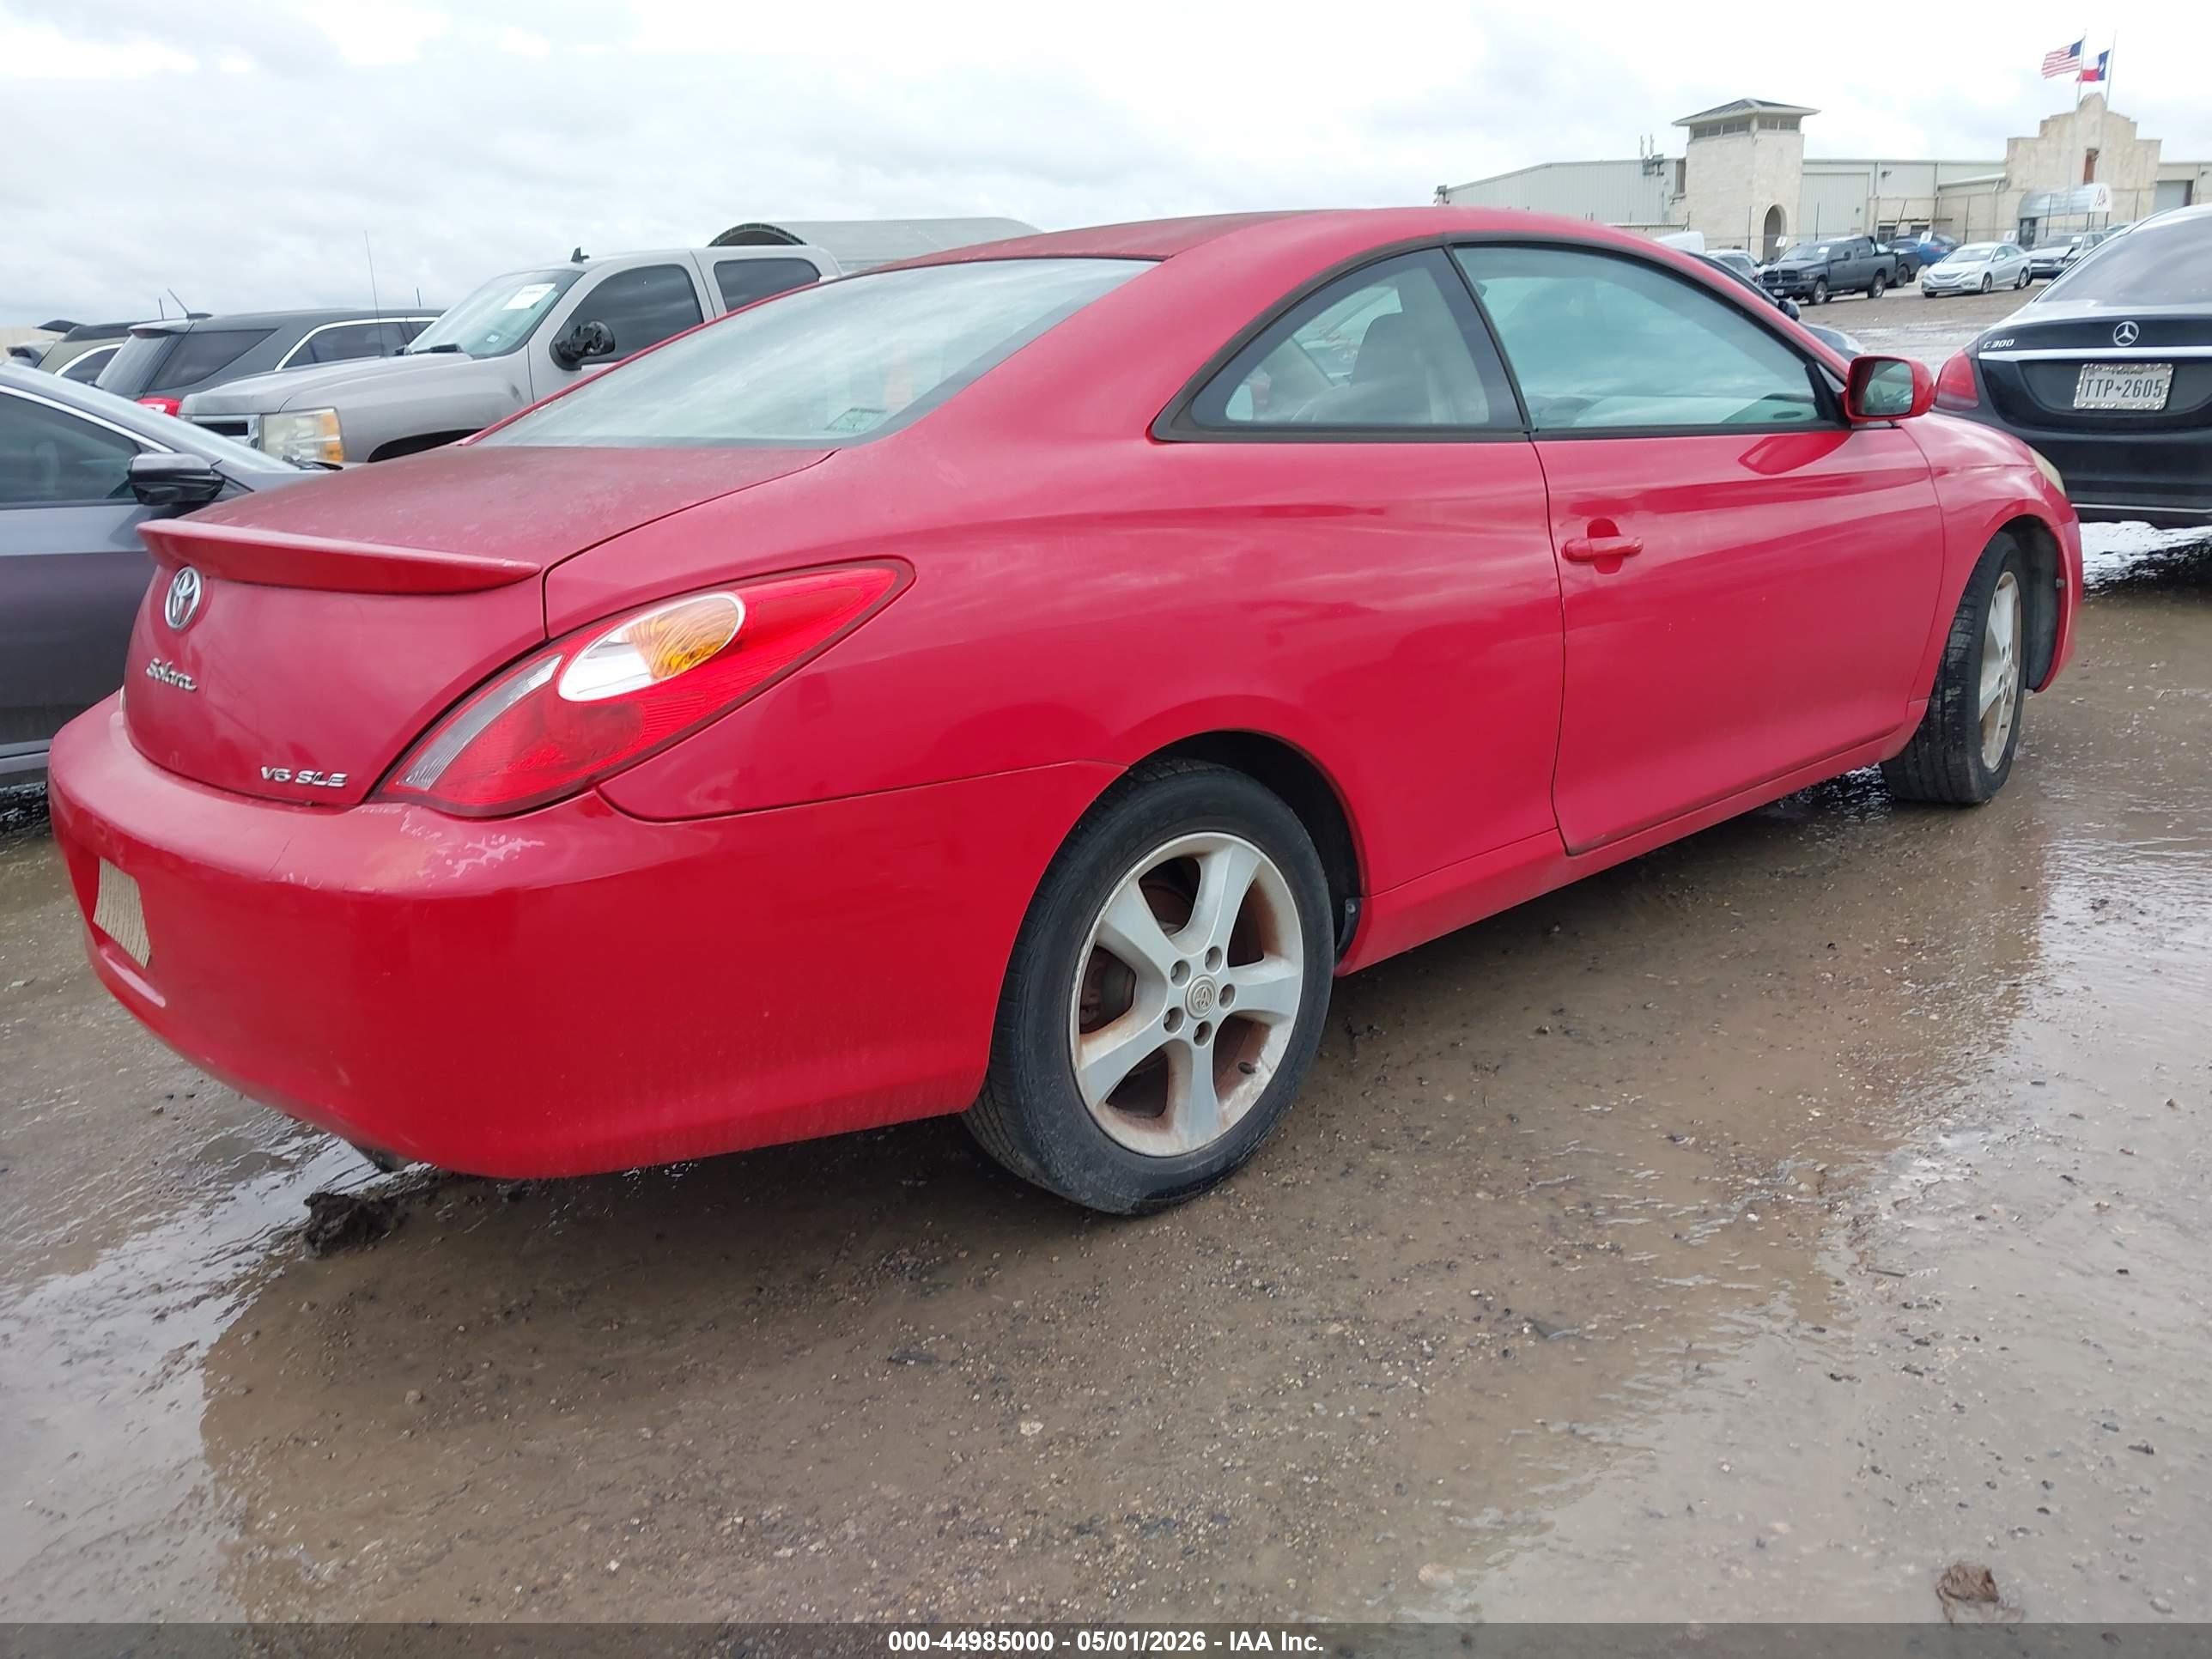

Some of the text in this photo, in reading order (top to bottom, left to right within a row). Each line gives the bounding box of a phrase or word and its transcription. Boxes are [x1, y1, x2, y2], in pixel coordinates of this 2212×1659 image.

[1991, 338, 2014, 349] 300
[146, 658, 198, 691] Solara
[261, 766, 348, 787] V6 SLE
